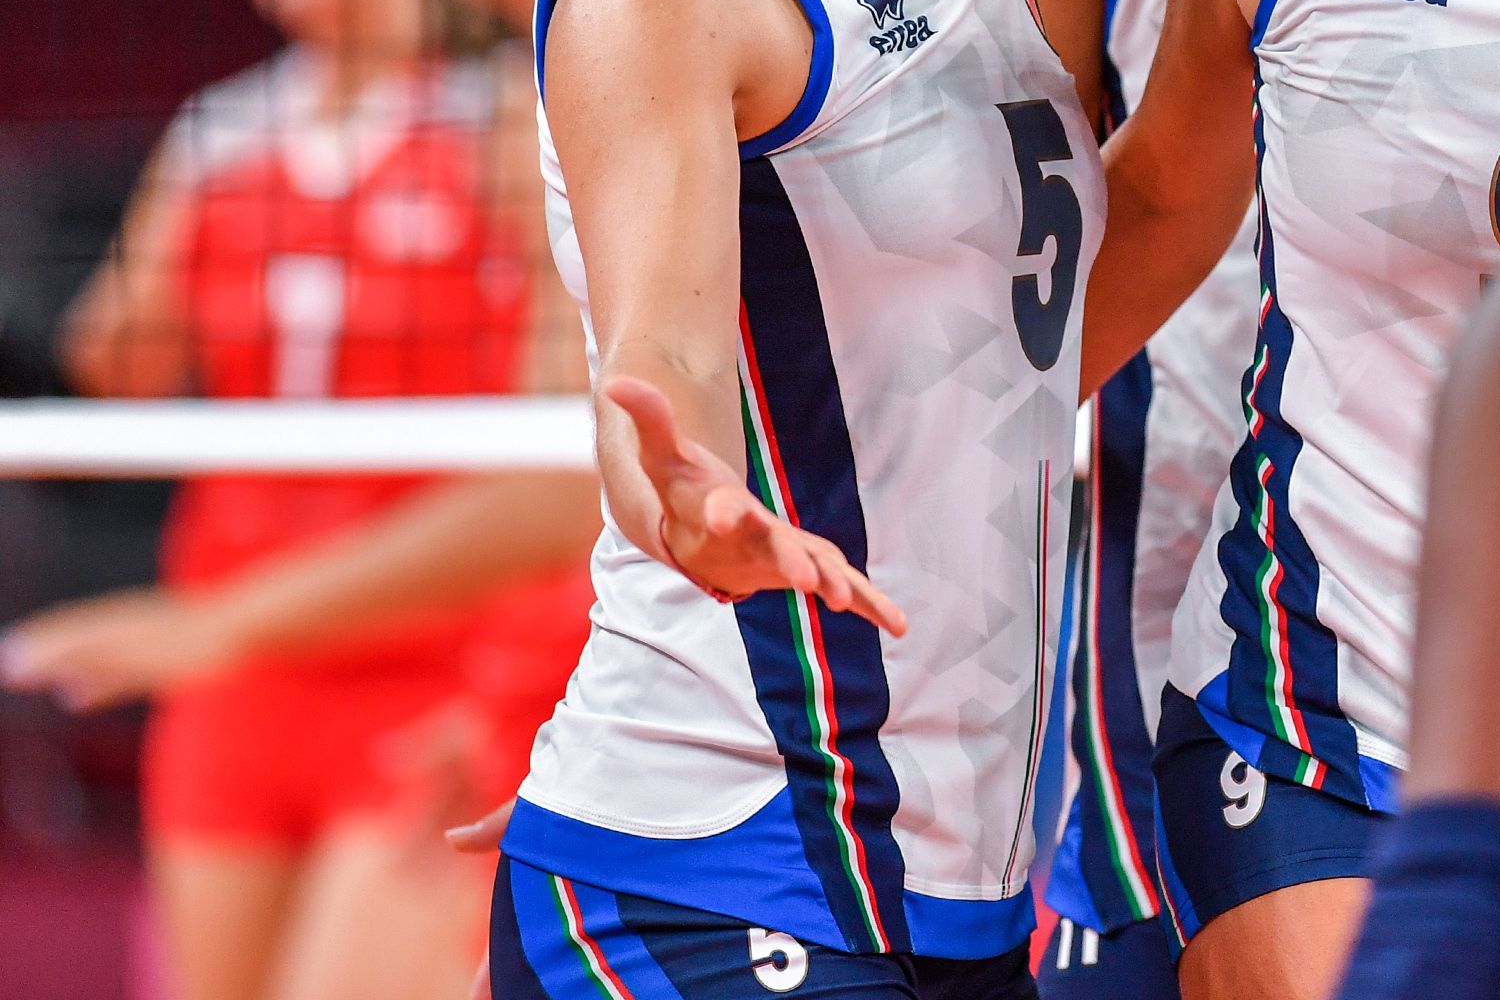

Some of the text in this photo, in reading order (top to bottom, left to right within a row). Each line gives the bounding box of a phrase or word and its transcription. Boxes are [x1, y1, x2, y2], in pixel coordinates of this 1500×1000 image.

[869, 15, 938, 56] errea
[994, 99, 1083, 371] 5
[1220, 751, 1267, 829] 9
[747, 928, 809, 993] 5
